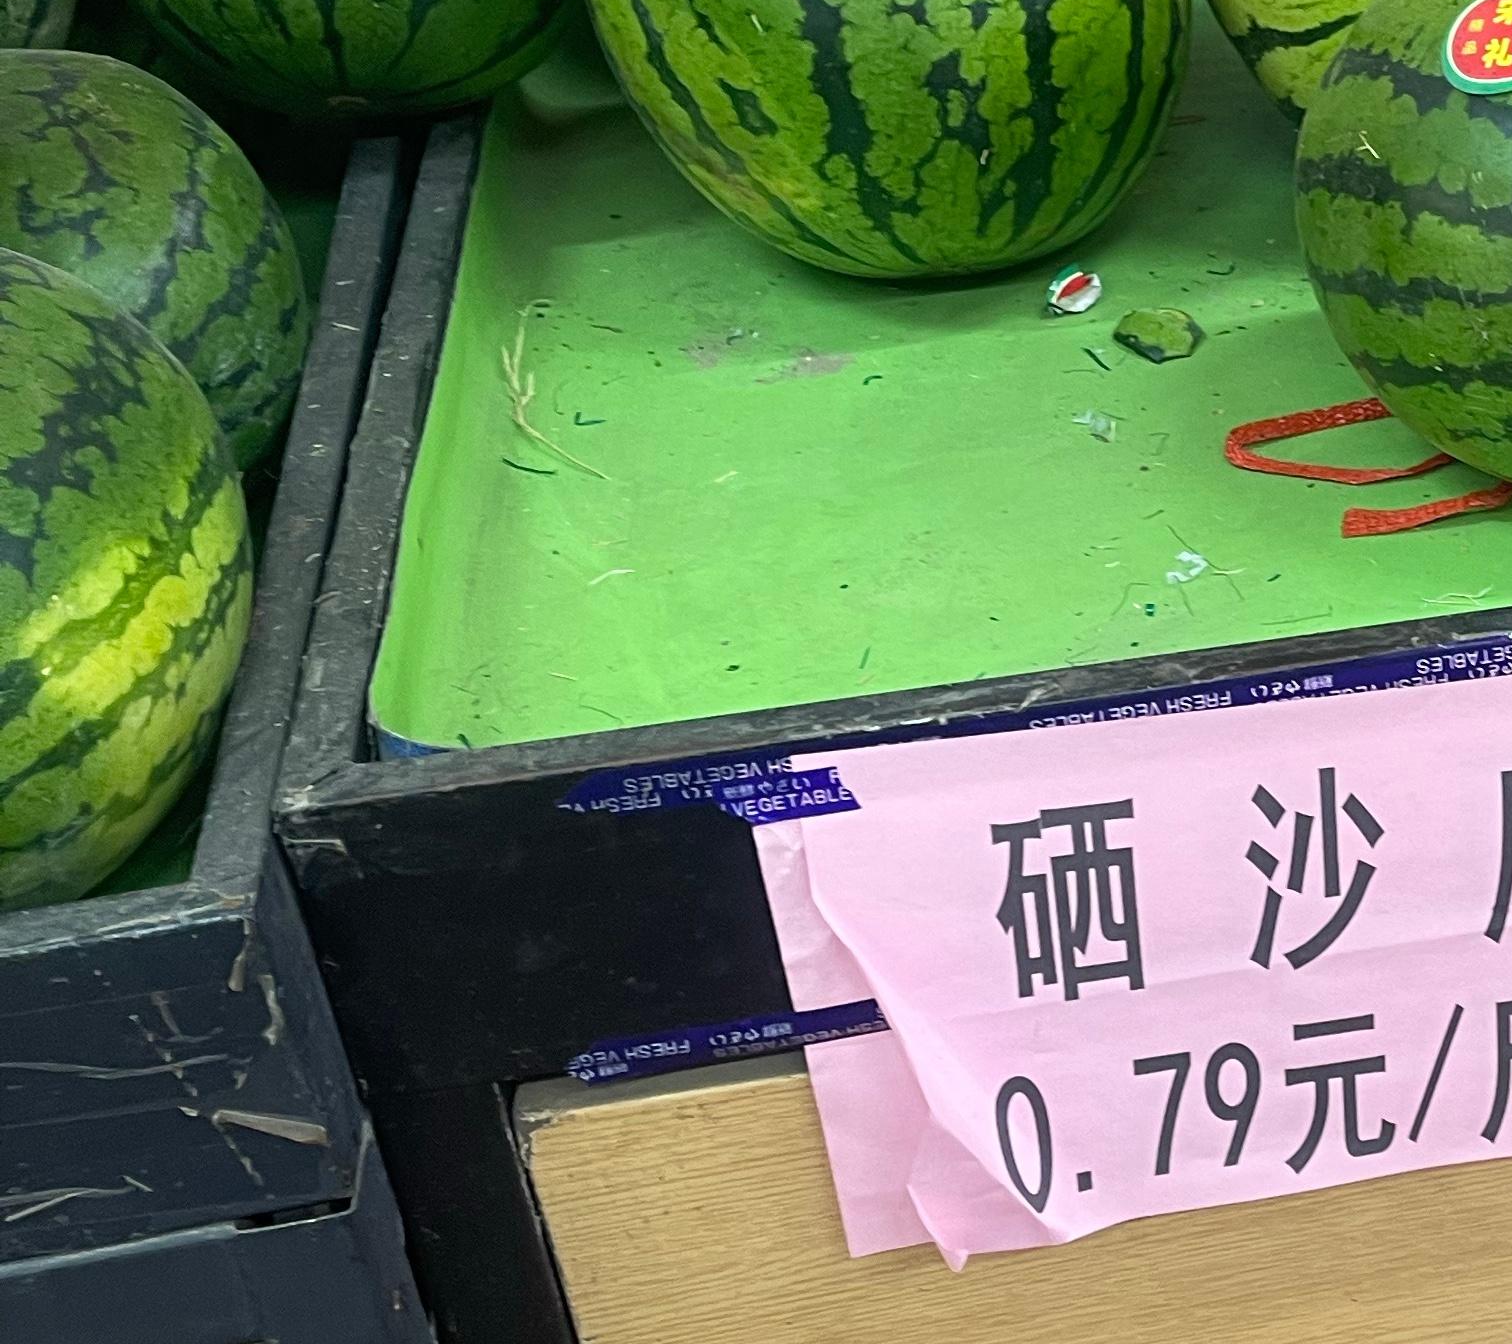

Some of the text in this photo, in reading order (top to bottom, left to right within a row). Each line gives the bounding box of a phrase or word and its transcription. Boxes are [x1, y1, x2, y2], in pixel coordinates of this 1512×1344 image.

[1165, 690, 1233, 713] FRESH
[623, 761, 762, 794] VEGETABLES
[624, 1039, 691, 1061] FRESH
